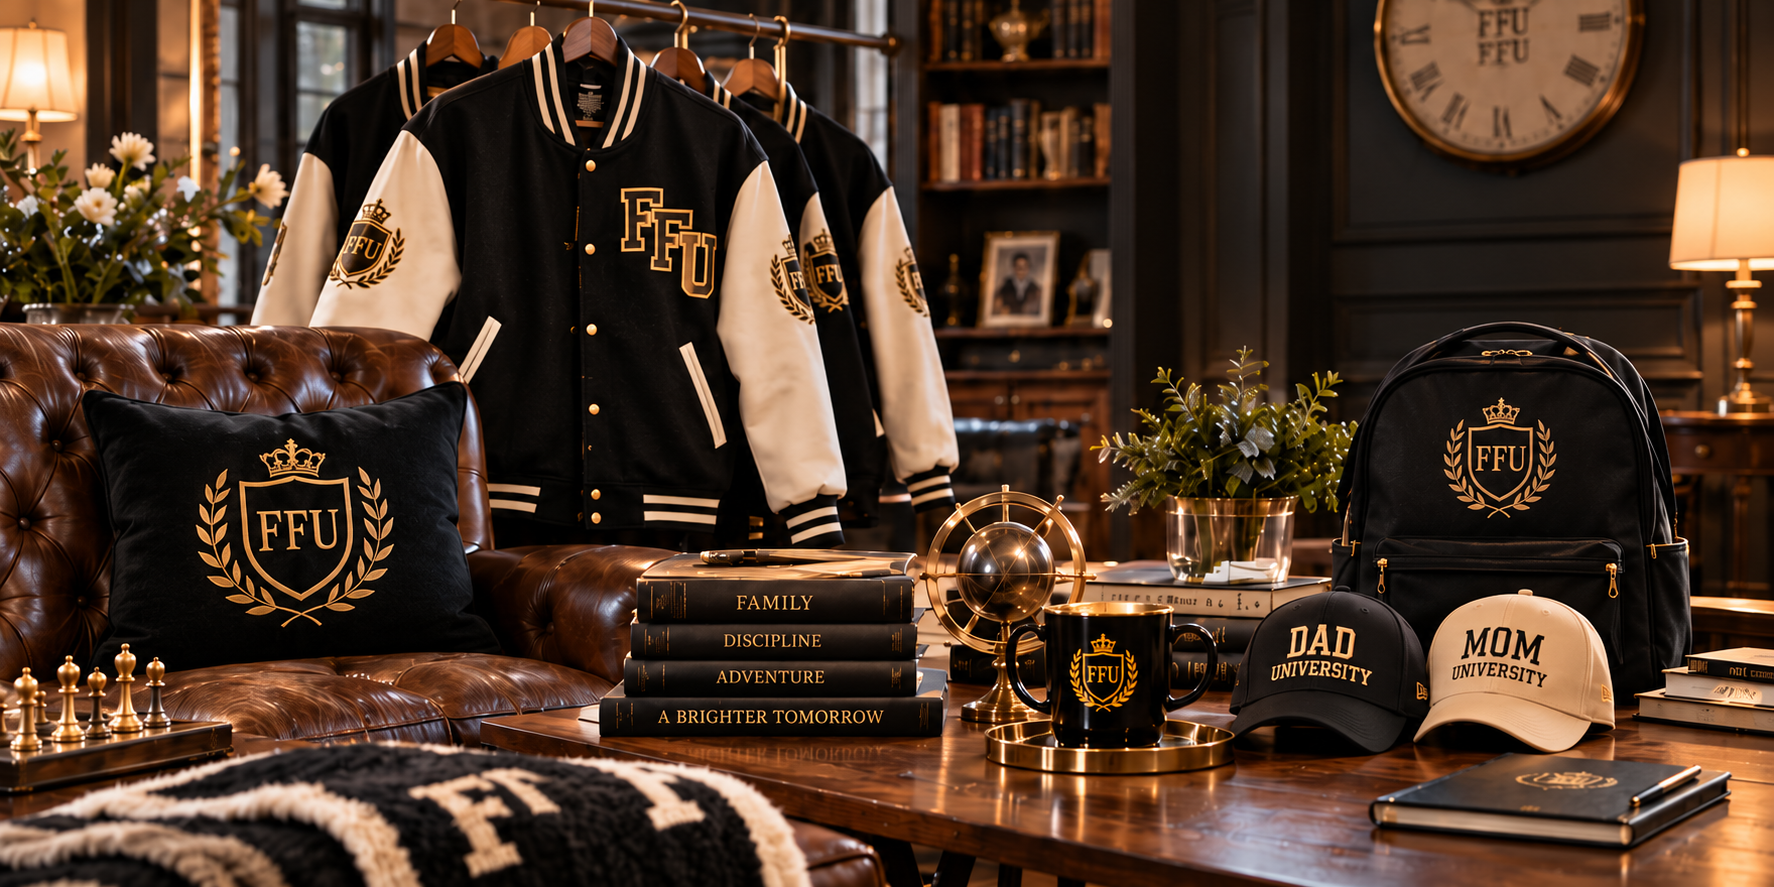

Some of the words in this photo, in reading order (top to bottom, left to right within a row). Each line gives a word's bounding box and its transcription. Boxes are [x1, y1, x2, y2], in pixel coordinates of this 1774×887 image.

[1478, 7, 1530, 38] FFU
[1478, 38, 1530, 66] FFU
[343, 235, 383, 259] FFU
[620, 187, 717, 299] FFU
[1475, 445, 1527, 472] FFU
[256, 508, 339, 552] FFU
[736, 595, 814, 611] FAMILY
[723, 634, 822, 648] DISCIPLINE
[1286, 624, 1356, 660] DAD
[1461, 627, 1545, 666] MOM
[716, 670, 825, 684] ADVENTURE
[1086, 665, 1119, 684] FFU
[1271, 660, 1373, 686] UNIVERSITY
[1451, 661, 1548, 688] UNIVERSITY
[658, 710, 670, 724] A
[676, 709, 767, 724] BRIGHTER
[773, 709, 884, 724] TOMORROW
